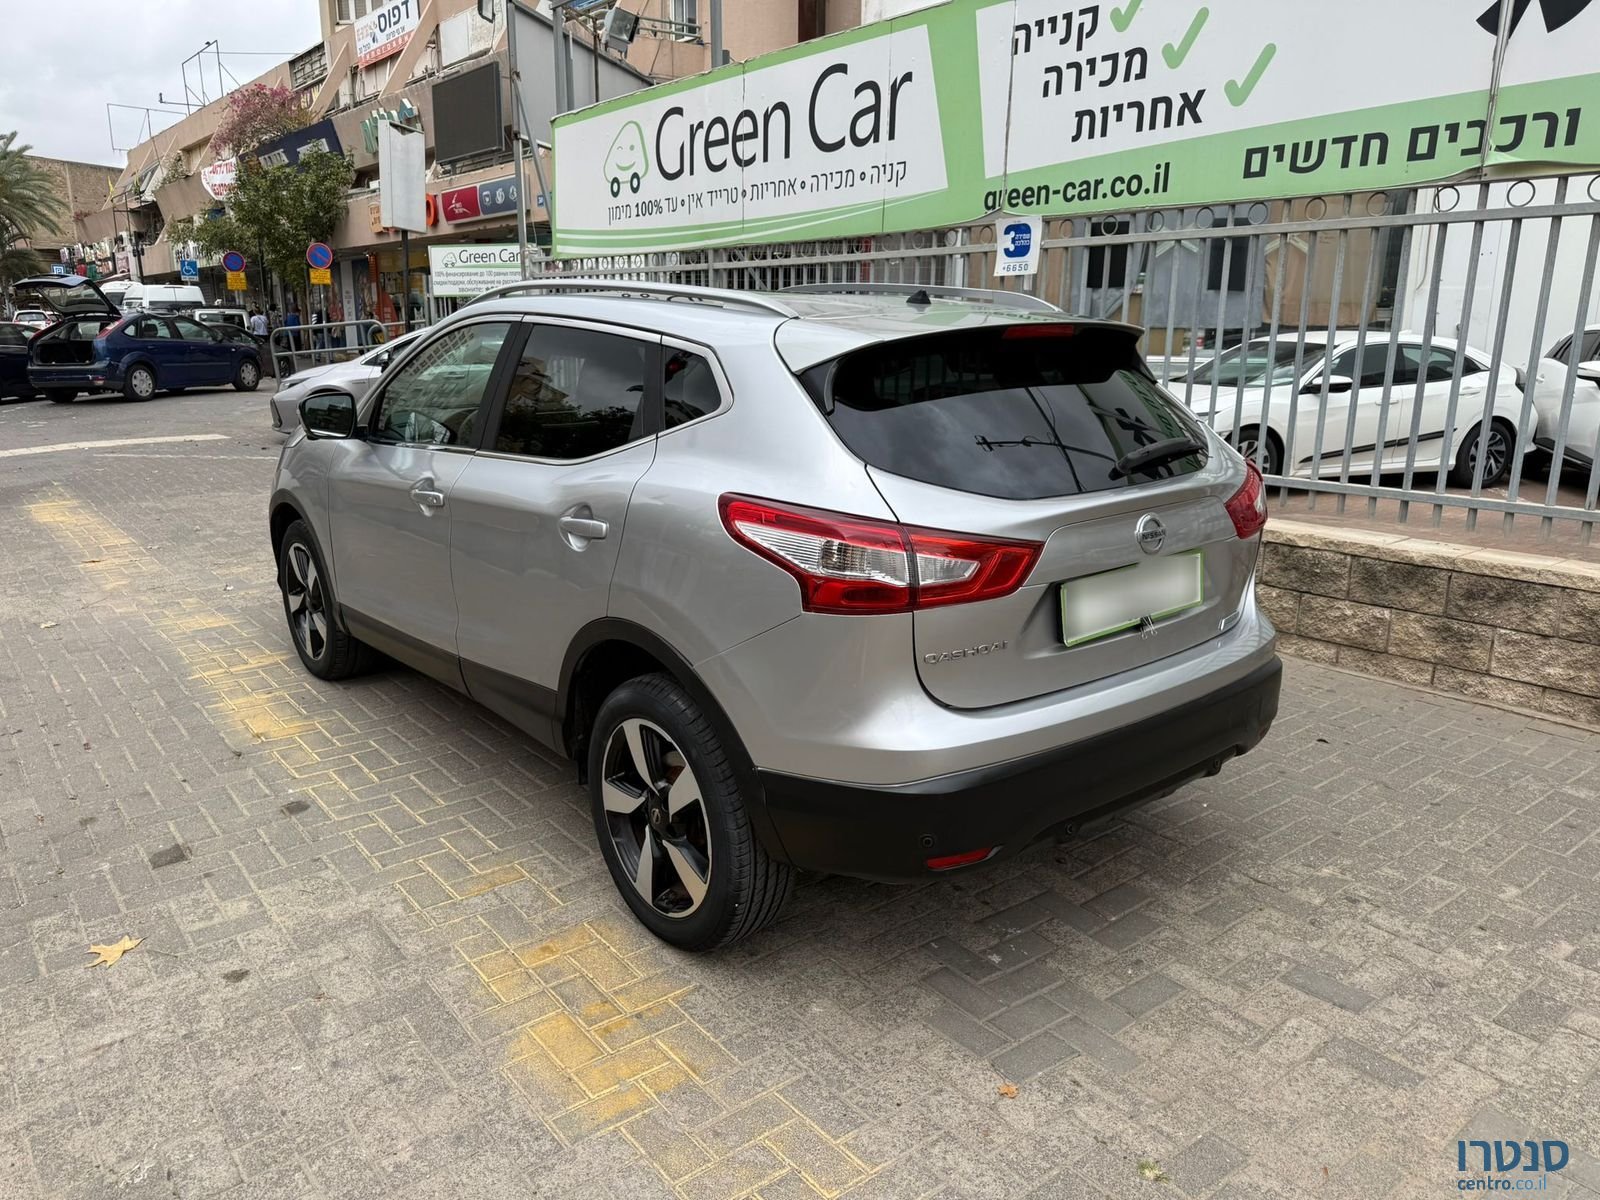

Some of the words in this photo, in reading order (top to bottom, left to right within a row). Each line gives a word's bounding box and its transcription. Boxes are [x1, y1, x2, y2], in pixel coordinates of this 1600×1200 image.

[377, 0, 410, 33] דפוס
[1013, 5, 1100, 56] קנייה
[1042, 46, 1148, 98] מכירה
[656, 101, 791, 181] Green
[808, 63, 913, 153] Car
[1071, 89, 1207, 143] אחריות
[1406, 107, 1582, 162] ורכבים
[1243, 131, 1390, 180] חדשים
[810, 168, 855, 193] מכירה
[870, 161, 907, 188] קניה
[984, 162, 1171, 213] green-car.co.il
[707, 187, 739, 207] טרייד
[750, 177, 797, 202] אחריות
[607, 203, 632, 226] מימון
[634, 198, 663, 217] 100%
[664, 197, 678, 213] עד
[687, 192, 704, 215] אין
[458, 249, 497, 264] Green
[499, 248, 521, 263] Car
